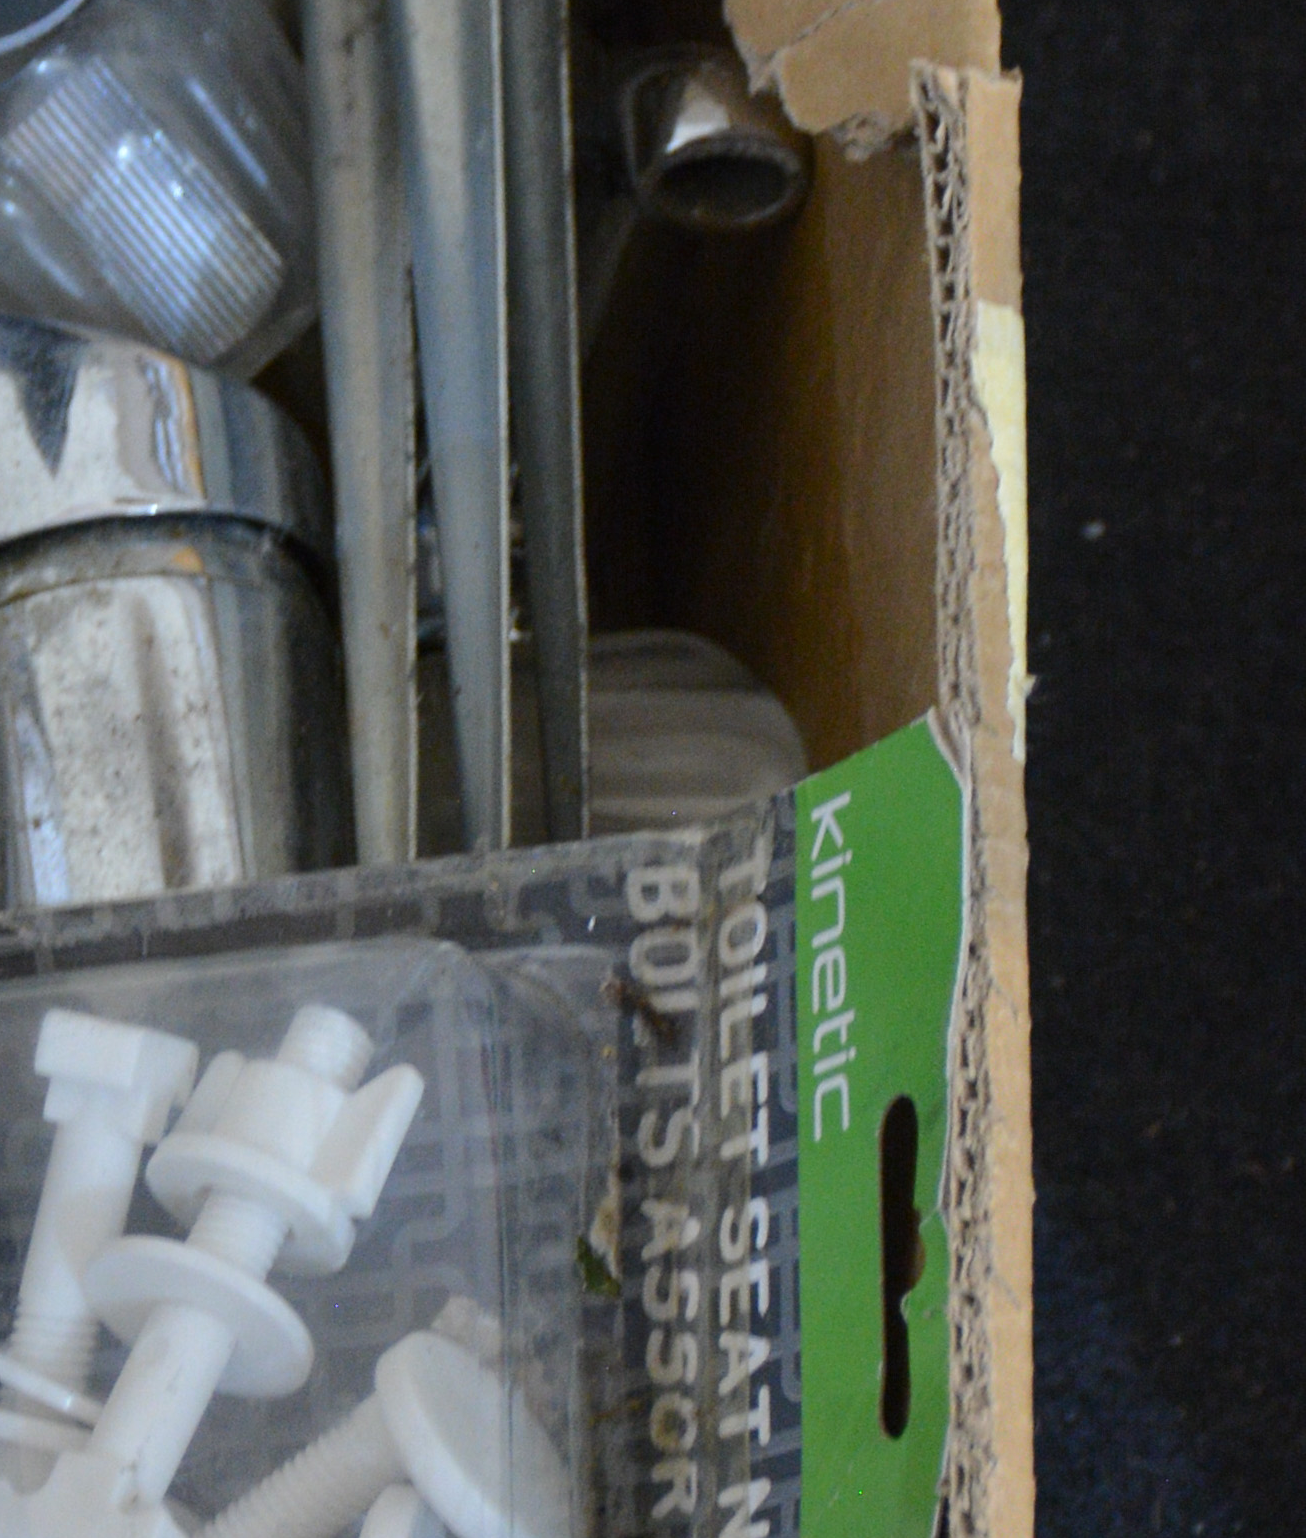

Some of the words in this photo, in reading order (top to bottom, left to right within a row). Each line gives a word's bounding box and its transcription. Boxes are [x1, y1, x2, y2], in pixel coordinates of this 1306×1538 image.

[717, 833, 773, 1169] TOILET
[809, 790, 857, 1145] kinetic
[717, 1196, 772, 1448] SEAT
